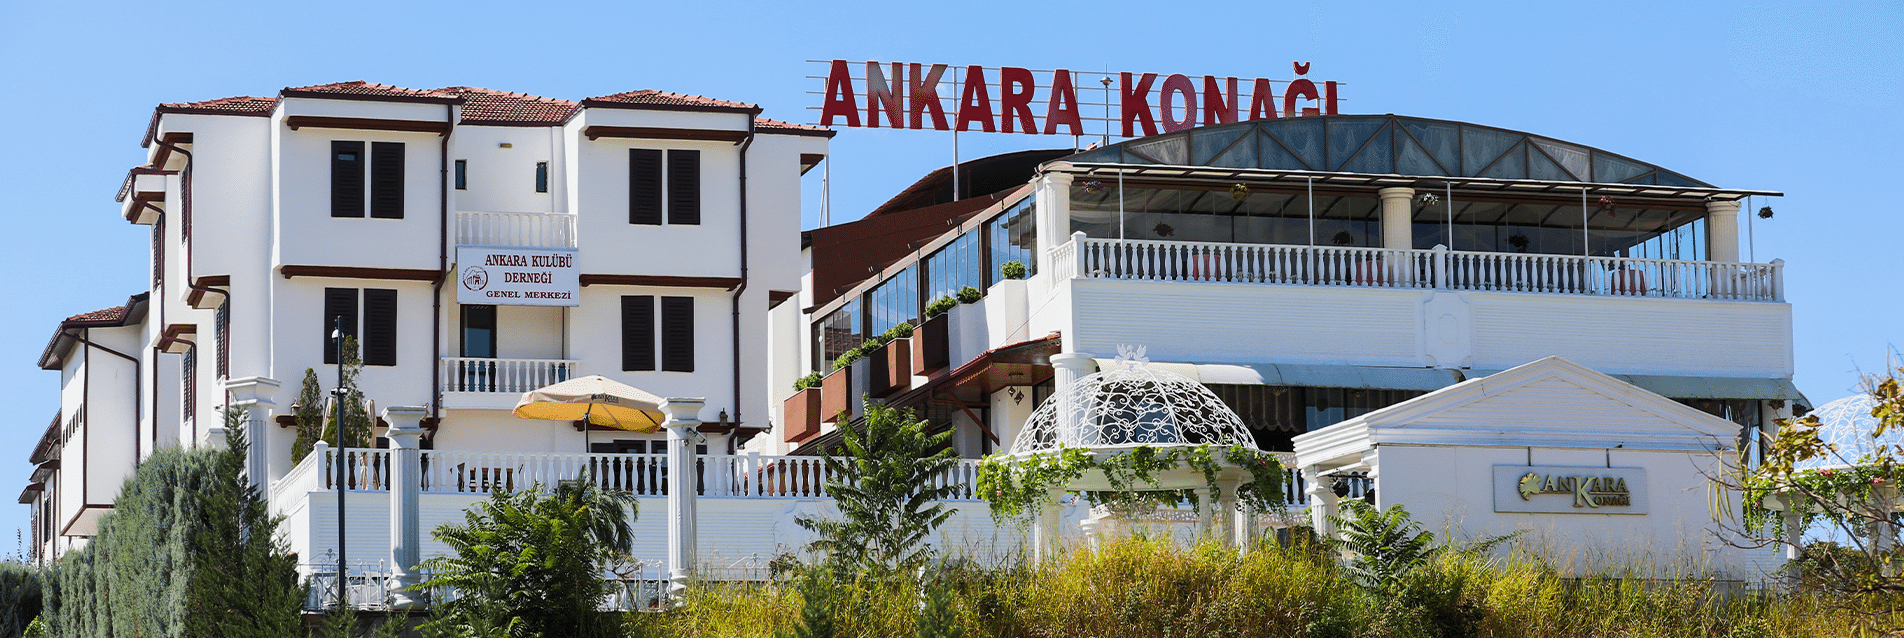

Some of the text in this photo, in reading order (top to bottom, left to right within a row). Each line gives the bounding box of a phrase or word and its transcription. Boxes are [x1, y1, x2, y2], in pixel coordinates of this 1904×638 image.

[820, 59, 1338, 137] ANKARA KONAĞI
[485, 253, 572, 268] ANKARA KULÜBÜ
[504, 271, 552, 284] DERNEĞİ
[486, 290, 521, 299] GENEL
[524, 290, 571, 299] MERKEZİ
[1543, 475, 1630, 508] ANKARA
